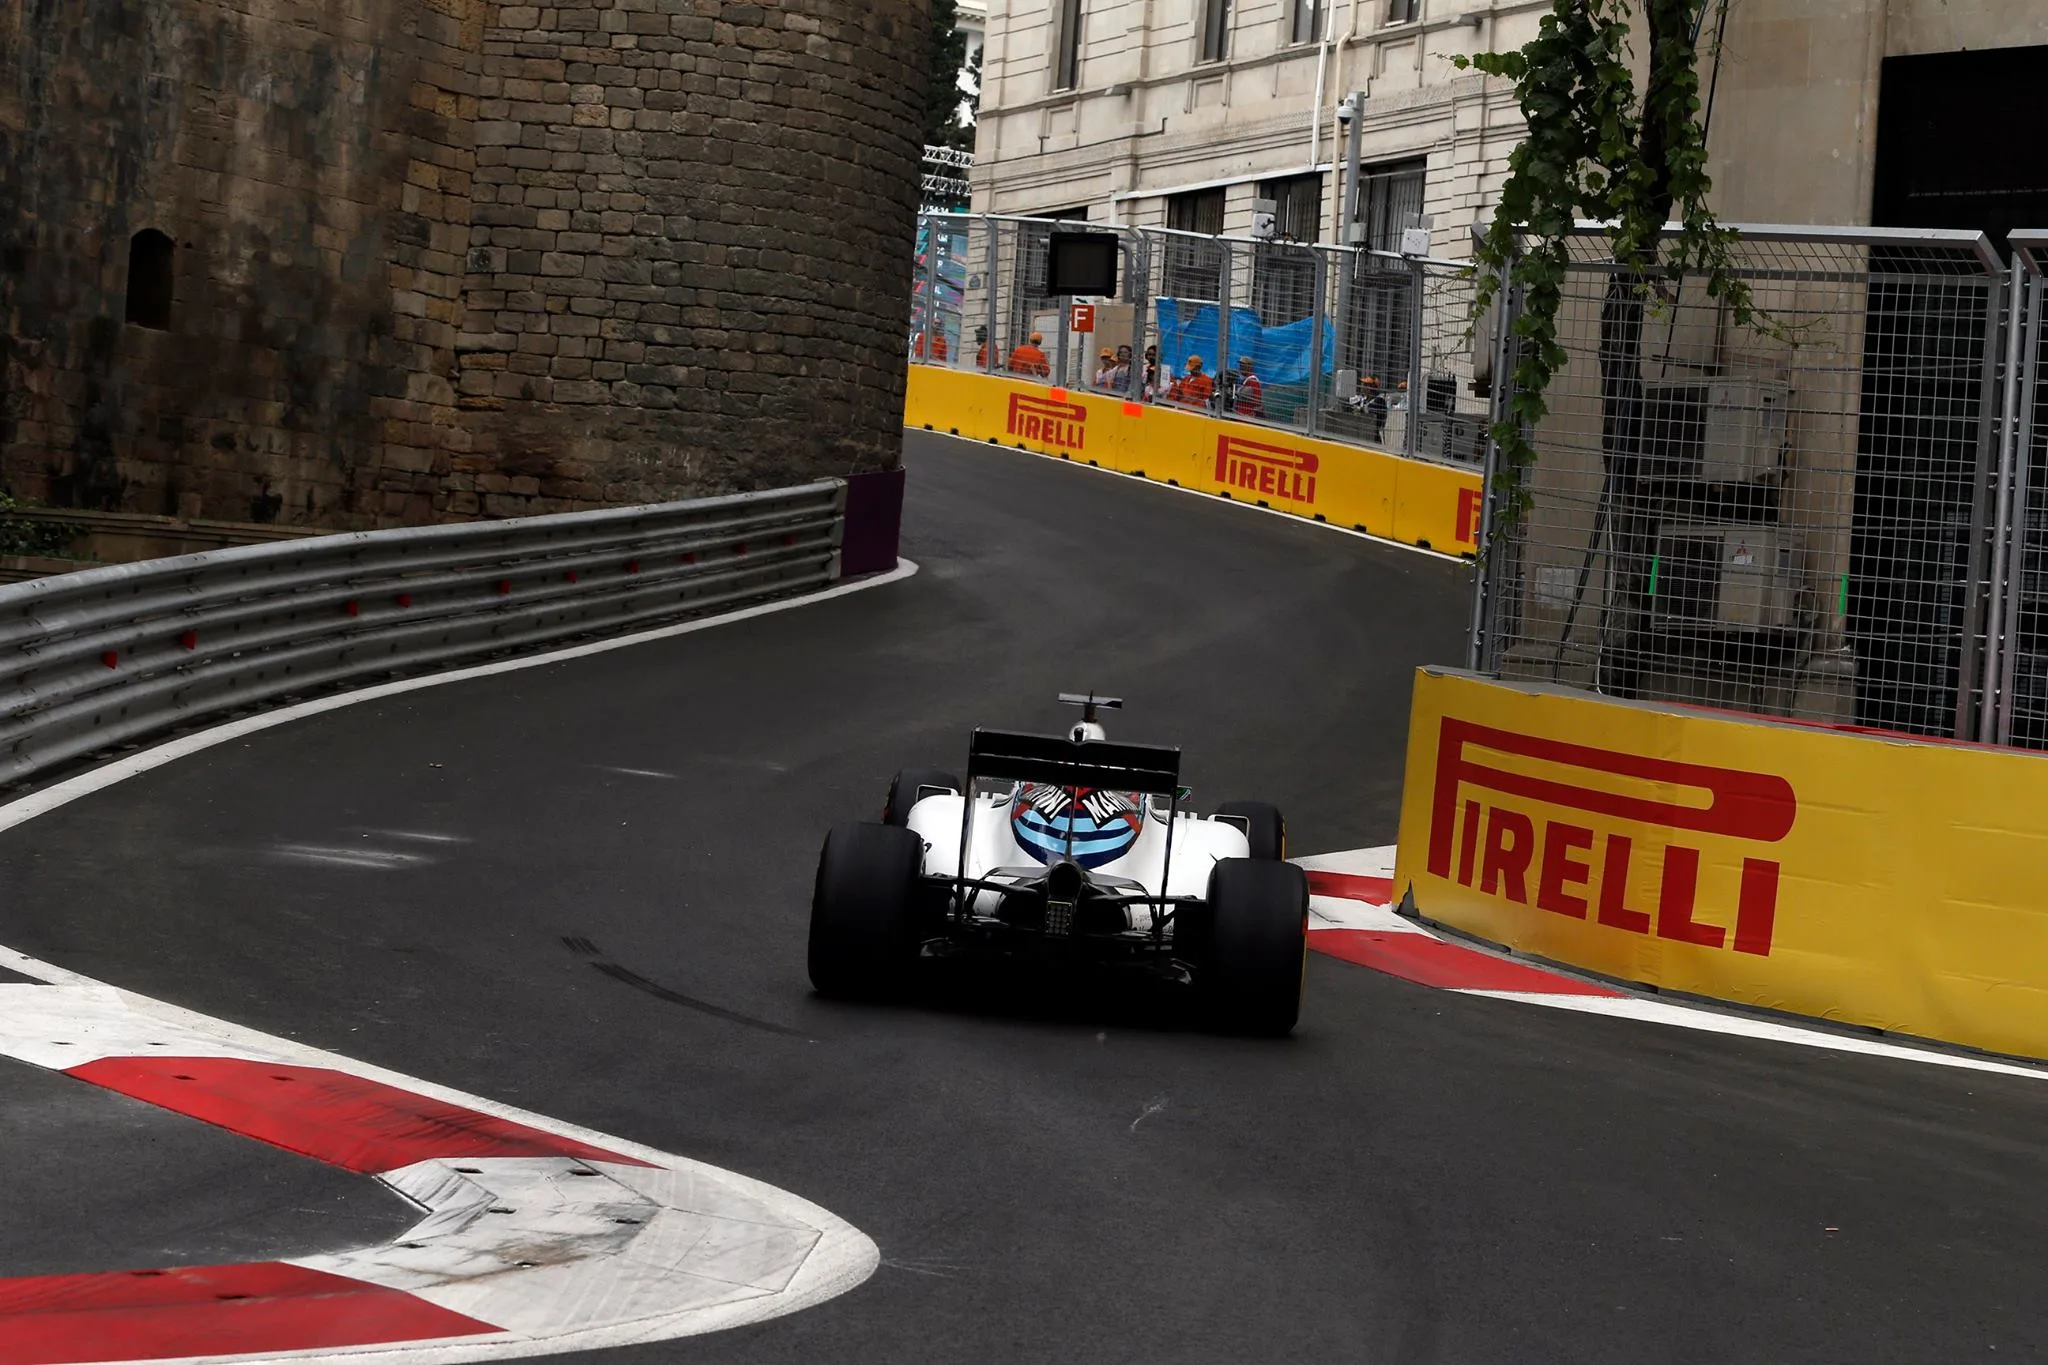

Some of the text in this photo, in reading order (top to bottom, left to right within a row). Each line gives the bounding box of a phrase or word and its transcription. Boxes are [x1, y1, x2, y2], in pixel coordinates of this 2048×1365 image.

[1074, 308, 1088, 328] F
[1007, 392, 1087, 449] PIRELLI
[1215, 434, 1319, 504] PIRELLI
[1427, 716, 1796, 956] PIRELLI
